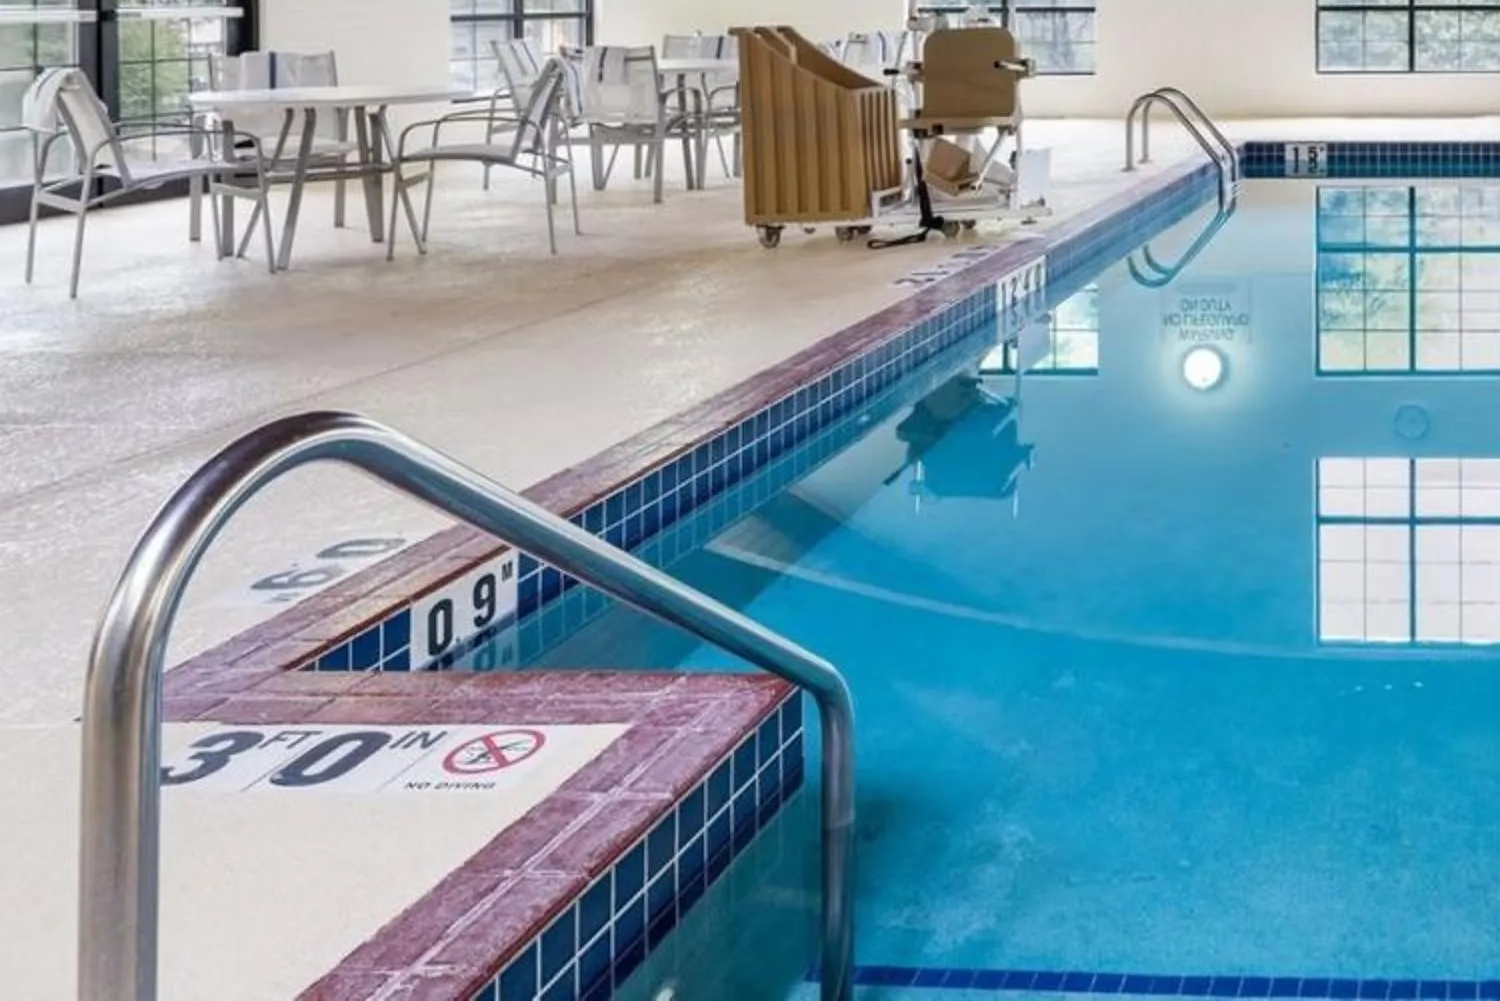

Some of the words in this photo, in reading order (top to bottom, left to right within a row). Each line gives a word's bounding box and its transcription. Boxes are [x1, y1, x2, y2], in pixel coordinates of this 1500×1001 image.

[501, 560, 513, 582] M
[258, 730, 323, 749] FT
[389, 730, 448, 750] IN
[160, 731, 265, 787] 3
[268, 731, 393, 788] 0
[404, 781, 431, 790] NO
[434, 781, 497, 790] DIVING
